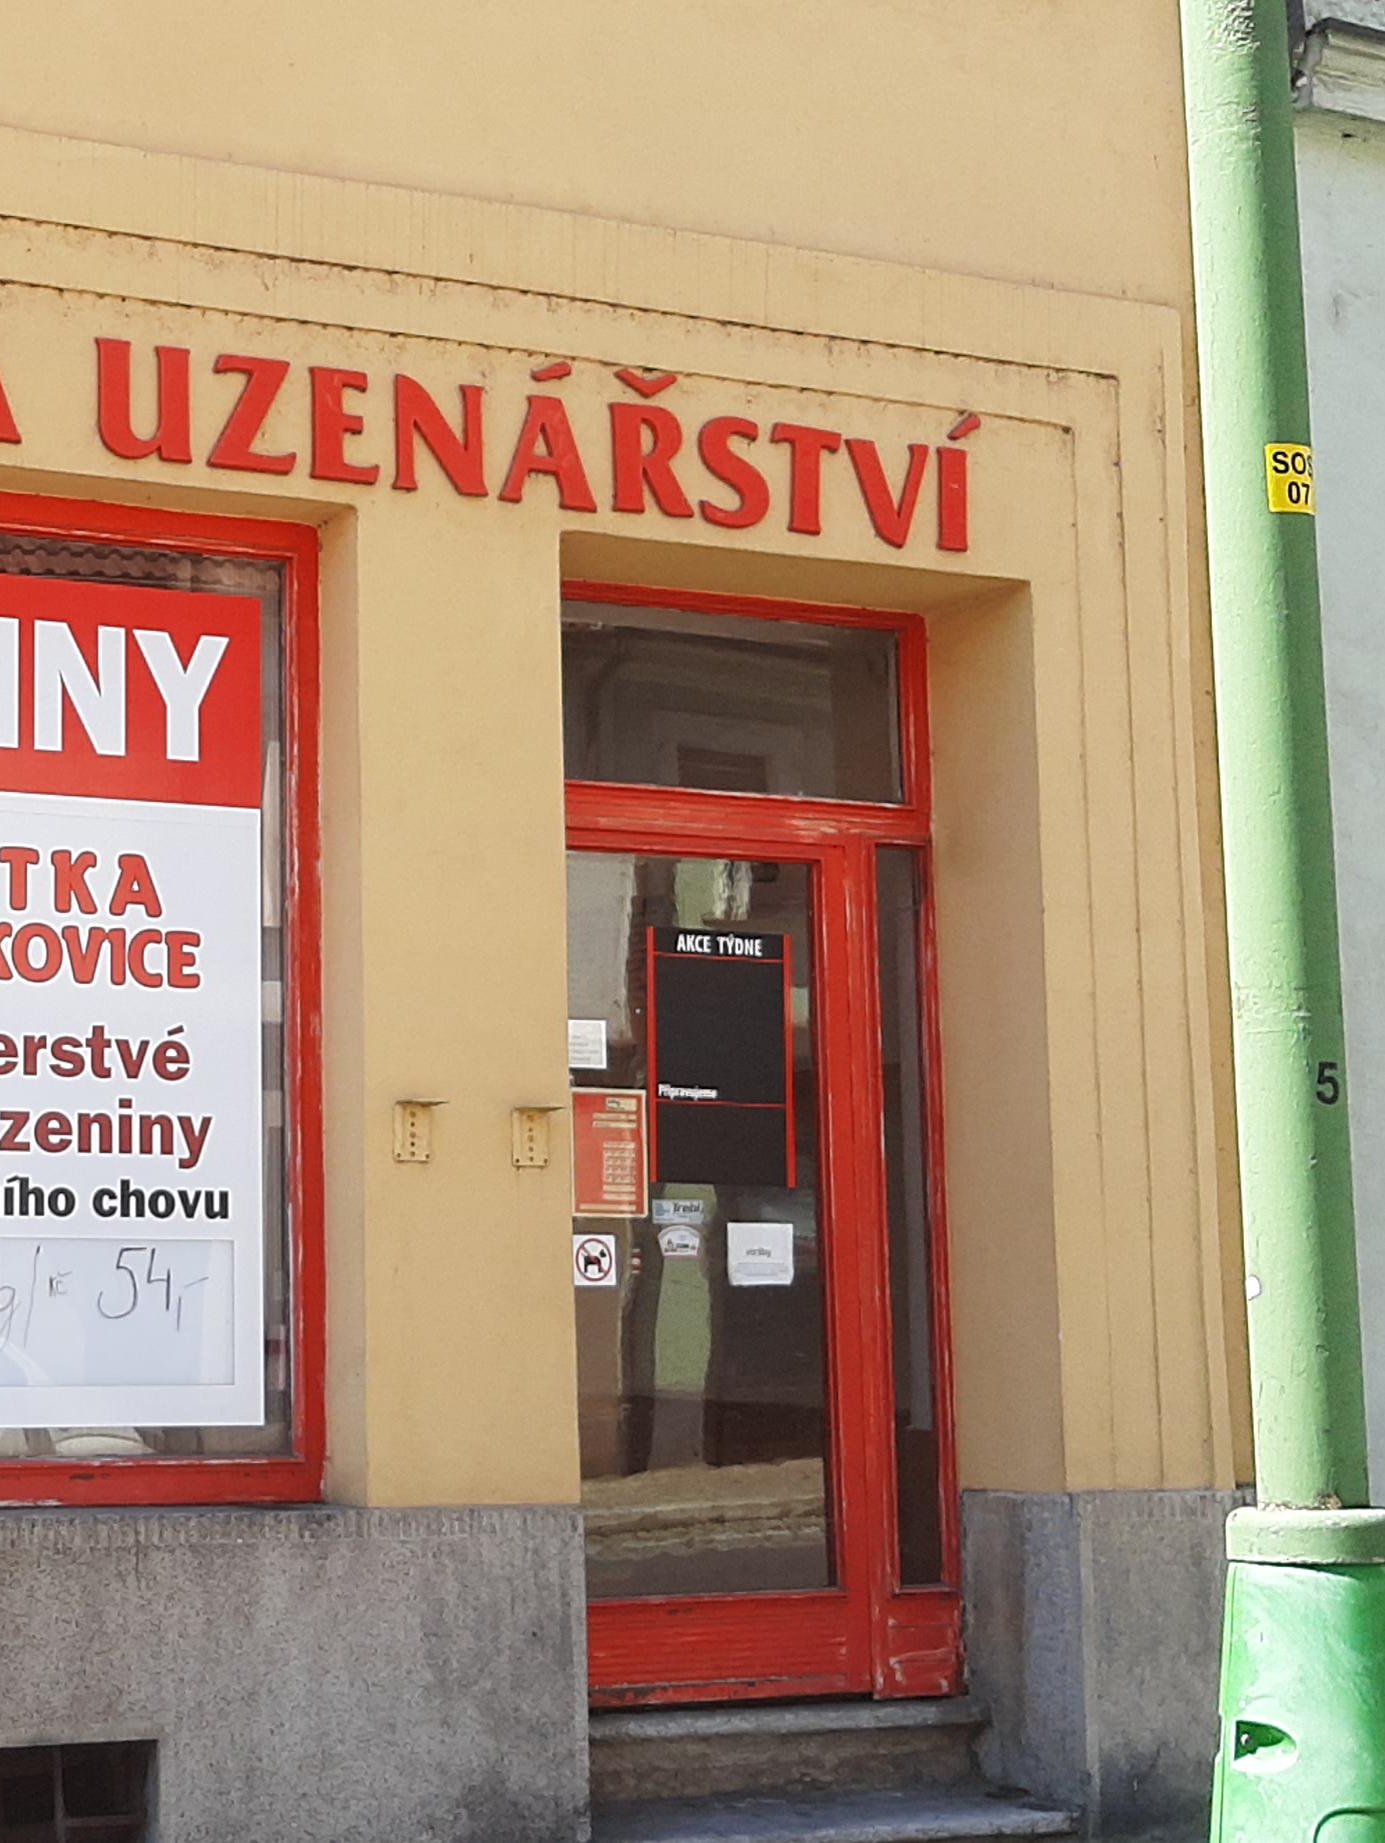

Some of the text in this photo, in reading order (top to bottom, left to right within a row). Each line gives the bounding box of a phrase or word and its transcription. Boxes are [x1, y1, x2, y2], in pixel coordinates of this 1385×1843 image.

[95, 337, 980, 553] UZENÁŘSTVÍ
[676, 933, 764, 958] AKCE TÝDNE
[1315, 1061, 1340, 1105] 5
[91, 1179, 230, 1220] chovu
